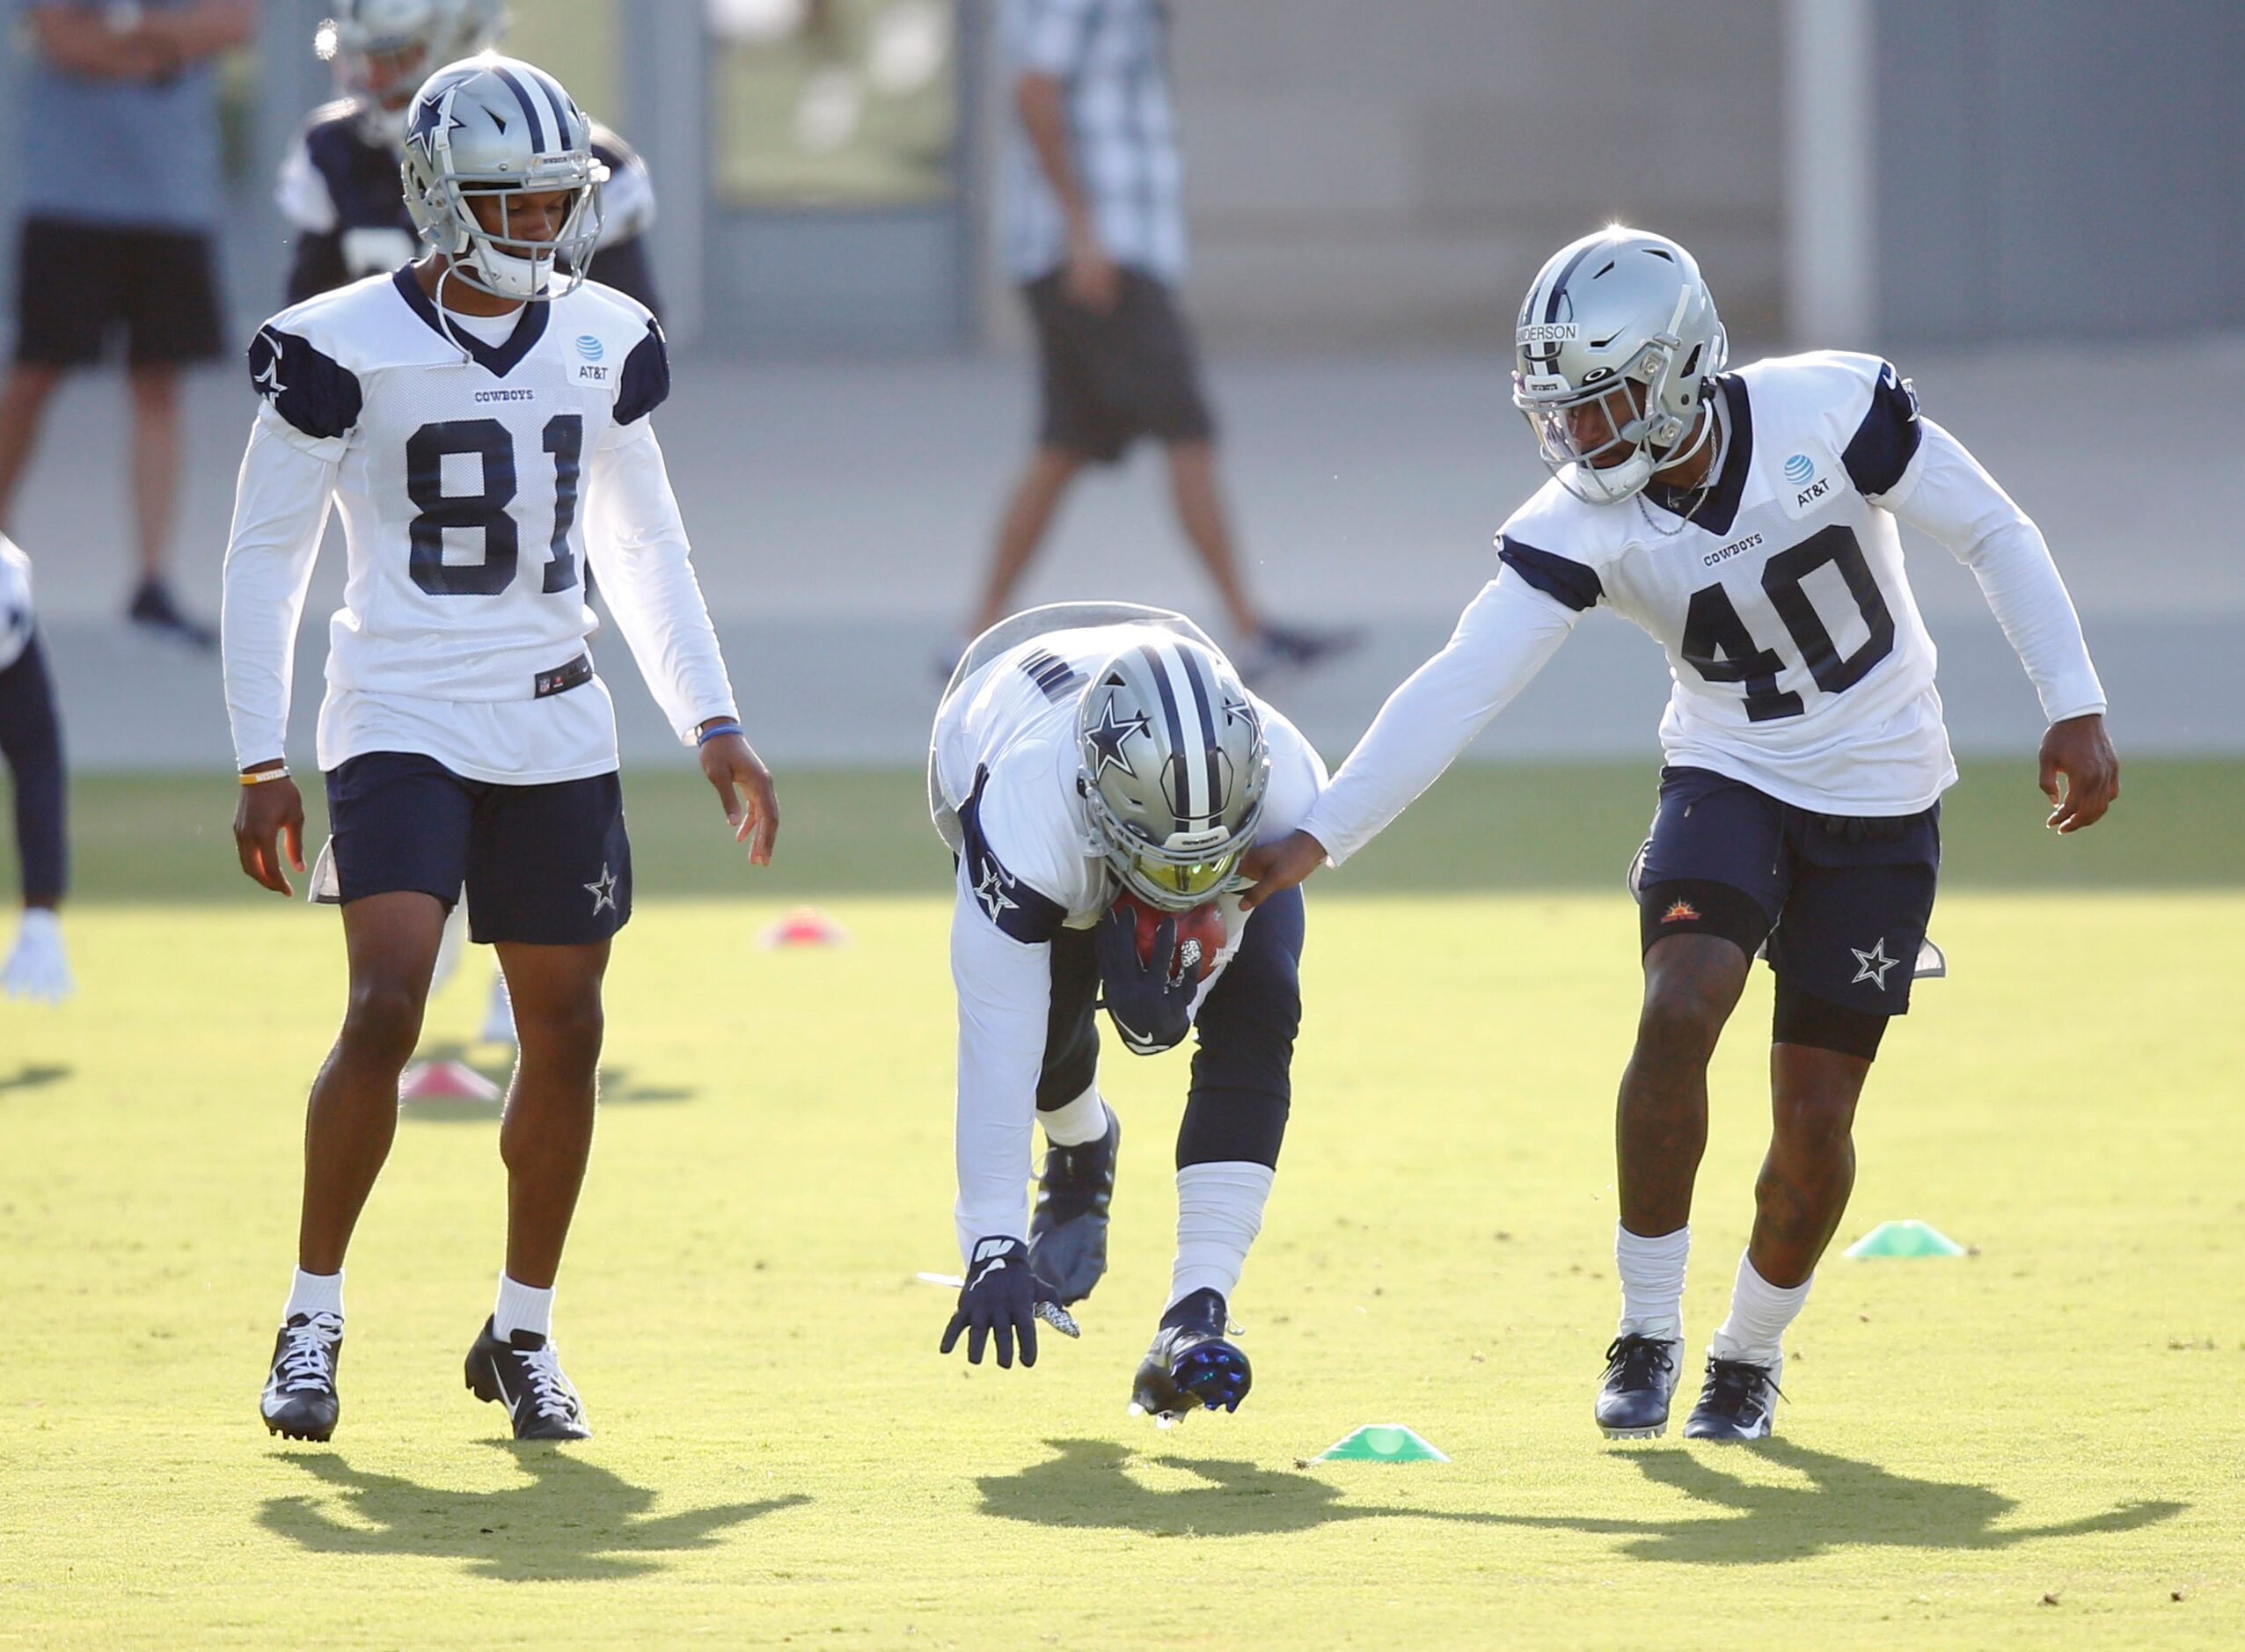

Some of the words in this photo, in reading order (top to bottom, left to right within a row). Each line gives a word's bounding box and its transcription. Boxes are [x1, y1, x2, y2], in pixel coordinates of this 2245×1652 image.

[579, 365, 609, 380] AT&T
[475, 390, 534, 403] COWBOYS
[406, 413, 583, 596] 81
[1796, 478, 1831, 508] AT&T
[1703, 532, 1763, 567] COWBOYS
[1681, 524, 1896, 723] 40
